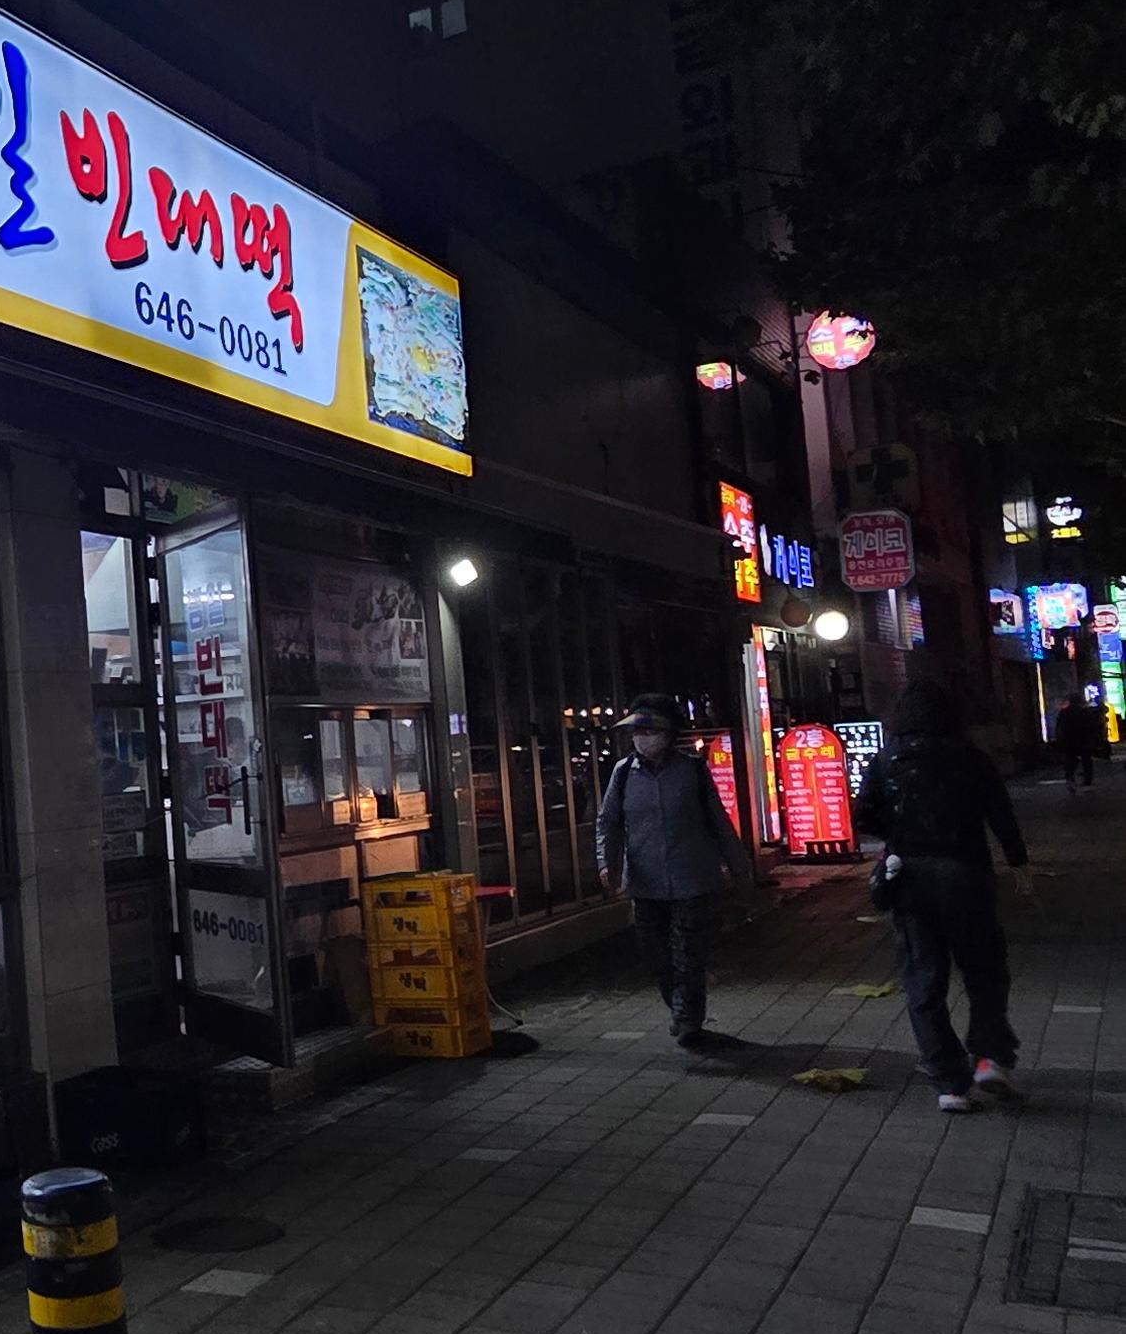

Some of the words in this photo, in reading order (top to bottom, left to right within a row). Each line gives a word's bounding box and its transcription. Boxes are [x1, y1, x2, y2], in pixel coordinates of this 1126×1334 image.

[135, 281, 288, 376] 646-0081
[794, 729, 826, 749] 2층
[191, 907, 266, 946] 646-0081
